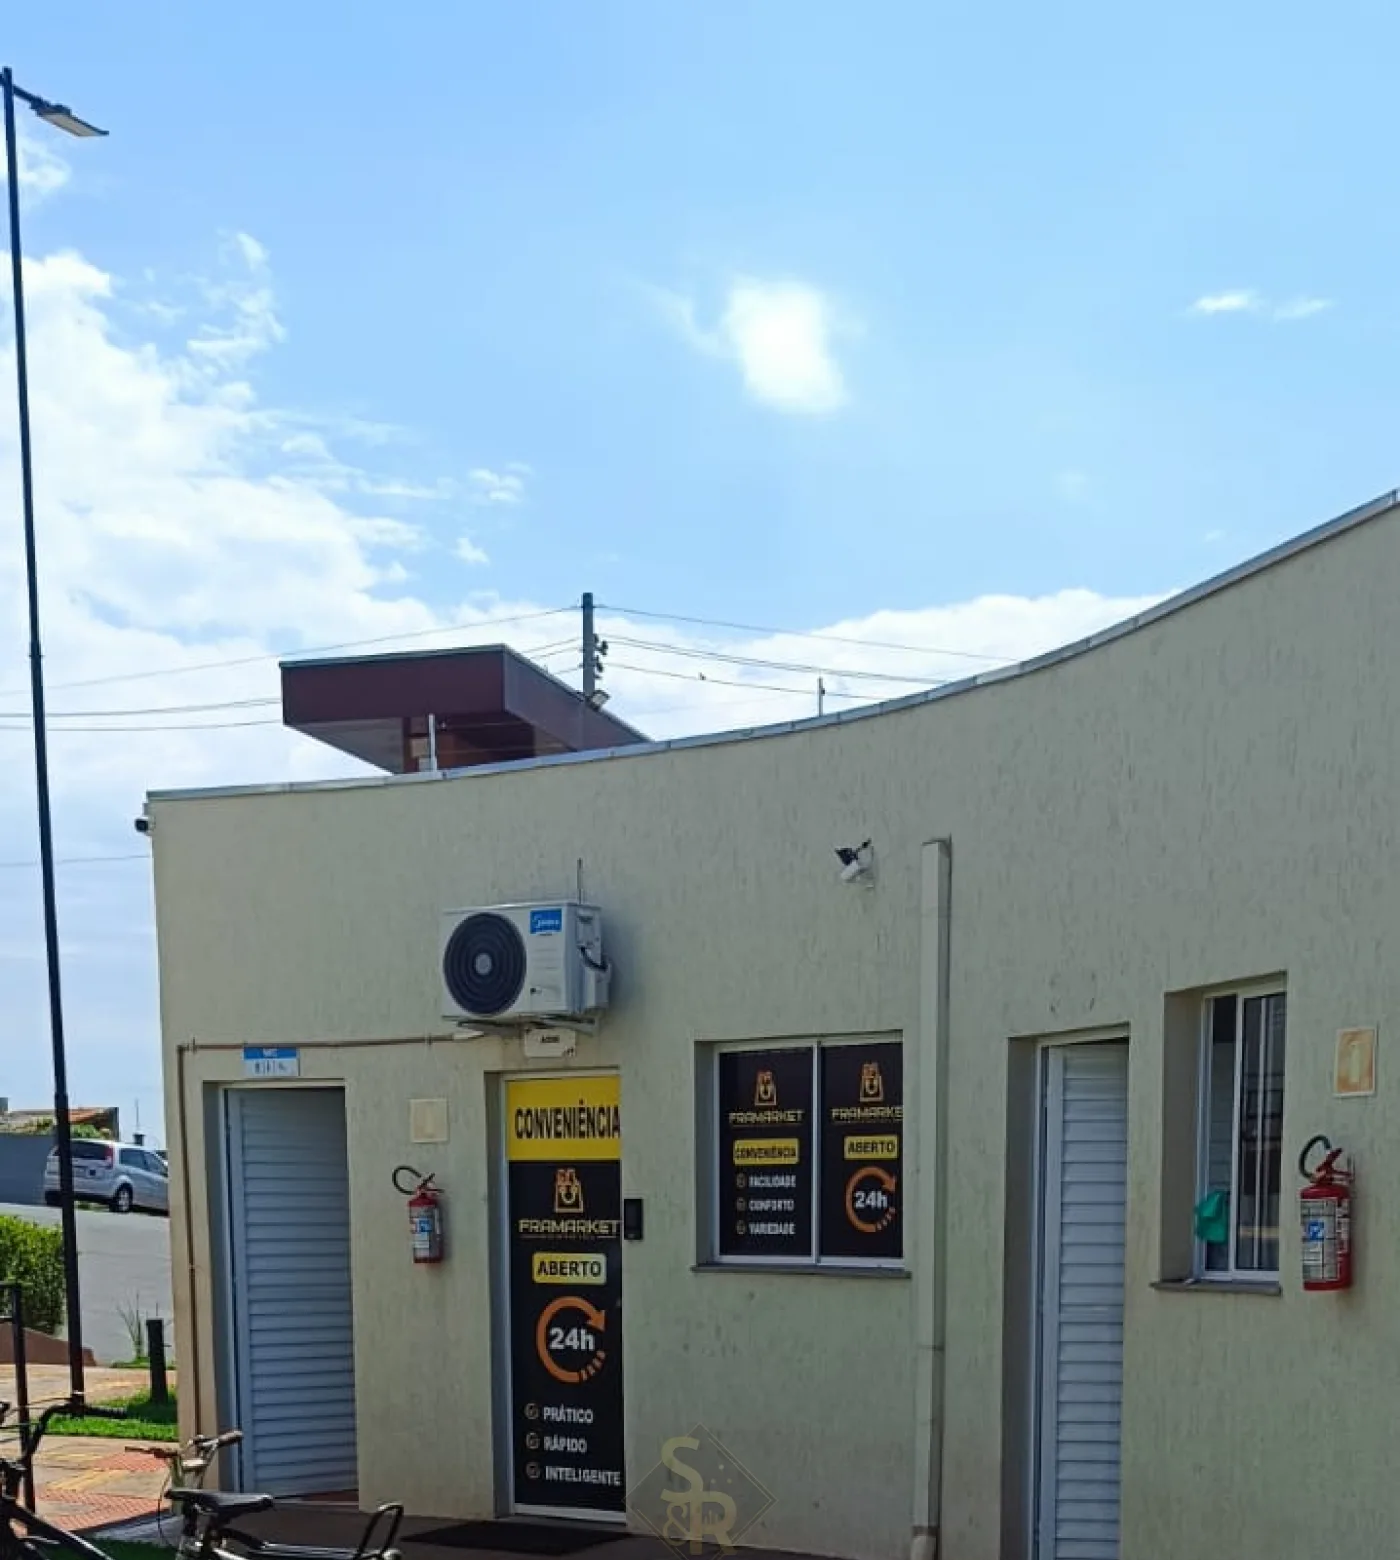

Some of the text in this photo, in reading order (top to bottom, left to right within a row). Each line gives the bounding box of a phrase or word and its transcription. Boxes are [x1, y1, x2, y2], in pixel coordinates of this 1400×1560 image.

[514, 1098, 621, 1140] CONVENIÊNCIA
[847, 1140, 896, 1156] ABERTO
[854, 1190, 888, 1211] 24h
[518, 1219, 622, 1234] FRAMARKET
[537, 1260, 601, 1278] ABERTO
[549, 1327, 596, 1351] 24h
[543, 1403, 594, 1424] PRÁTICO
[543, 1434, 587, 1453] RÁPIDO
[545, 1465, 622, 1486] INTELIGENTE
